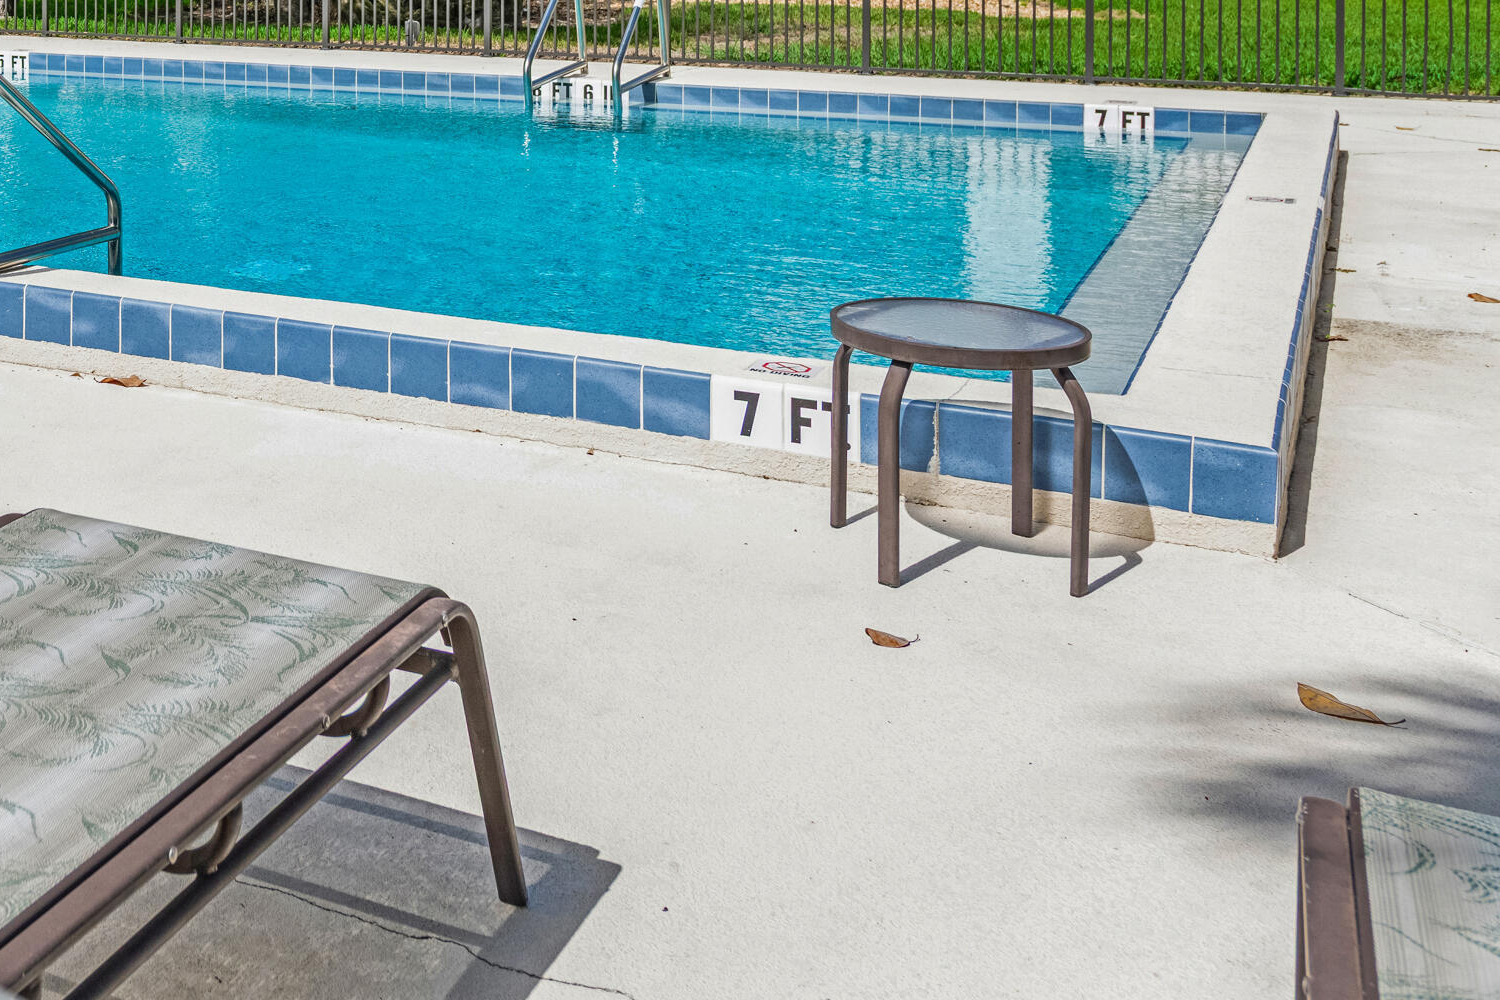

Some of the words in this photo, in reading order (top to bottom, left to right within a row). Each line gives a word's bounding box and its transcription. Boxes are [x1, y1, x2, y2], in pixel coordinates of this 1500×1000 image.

[583, 84, 594, 101] 6
[1095, 109, 1107, 128] 7
[733, 390, 760, 437] 7
